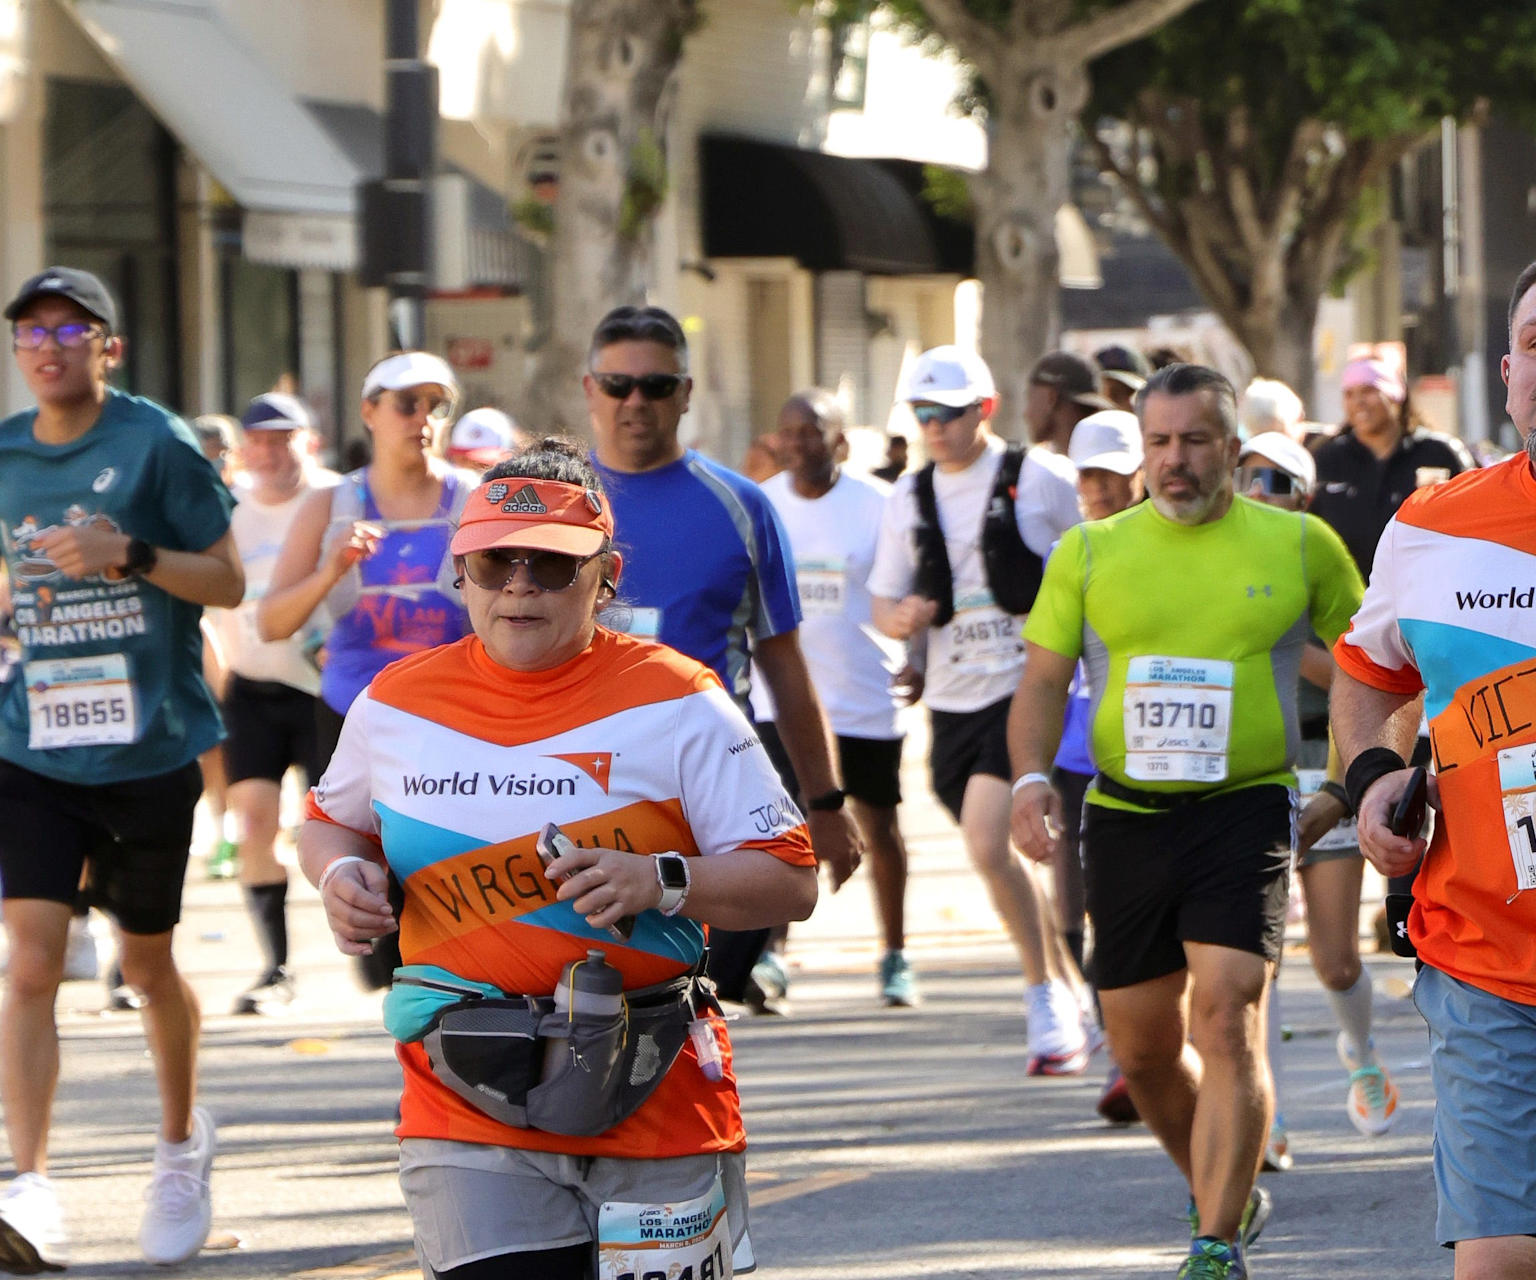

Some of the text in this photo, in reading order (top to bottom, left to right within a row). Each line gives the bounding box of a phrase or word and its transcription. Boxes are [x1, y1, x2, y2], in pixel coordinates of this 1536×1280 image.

[503, 503, 545, 512] adidas
[51, 596, 143, 622] ANGELES
[1456, 587, 1535, 610] World
[18, 614, 147, 646] MARATHON
[1149, 673, 1206, 682] MARATHON
[39, 699, 126, 729] 18655
[1134, 702, 1216, 729] 13710
[403, 771, 577, 797] World Vision
